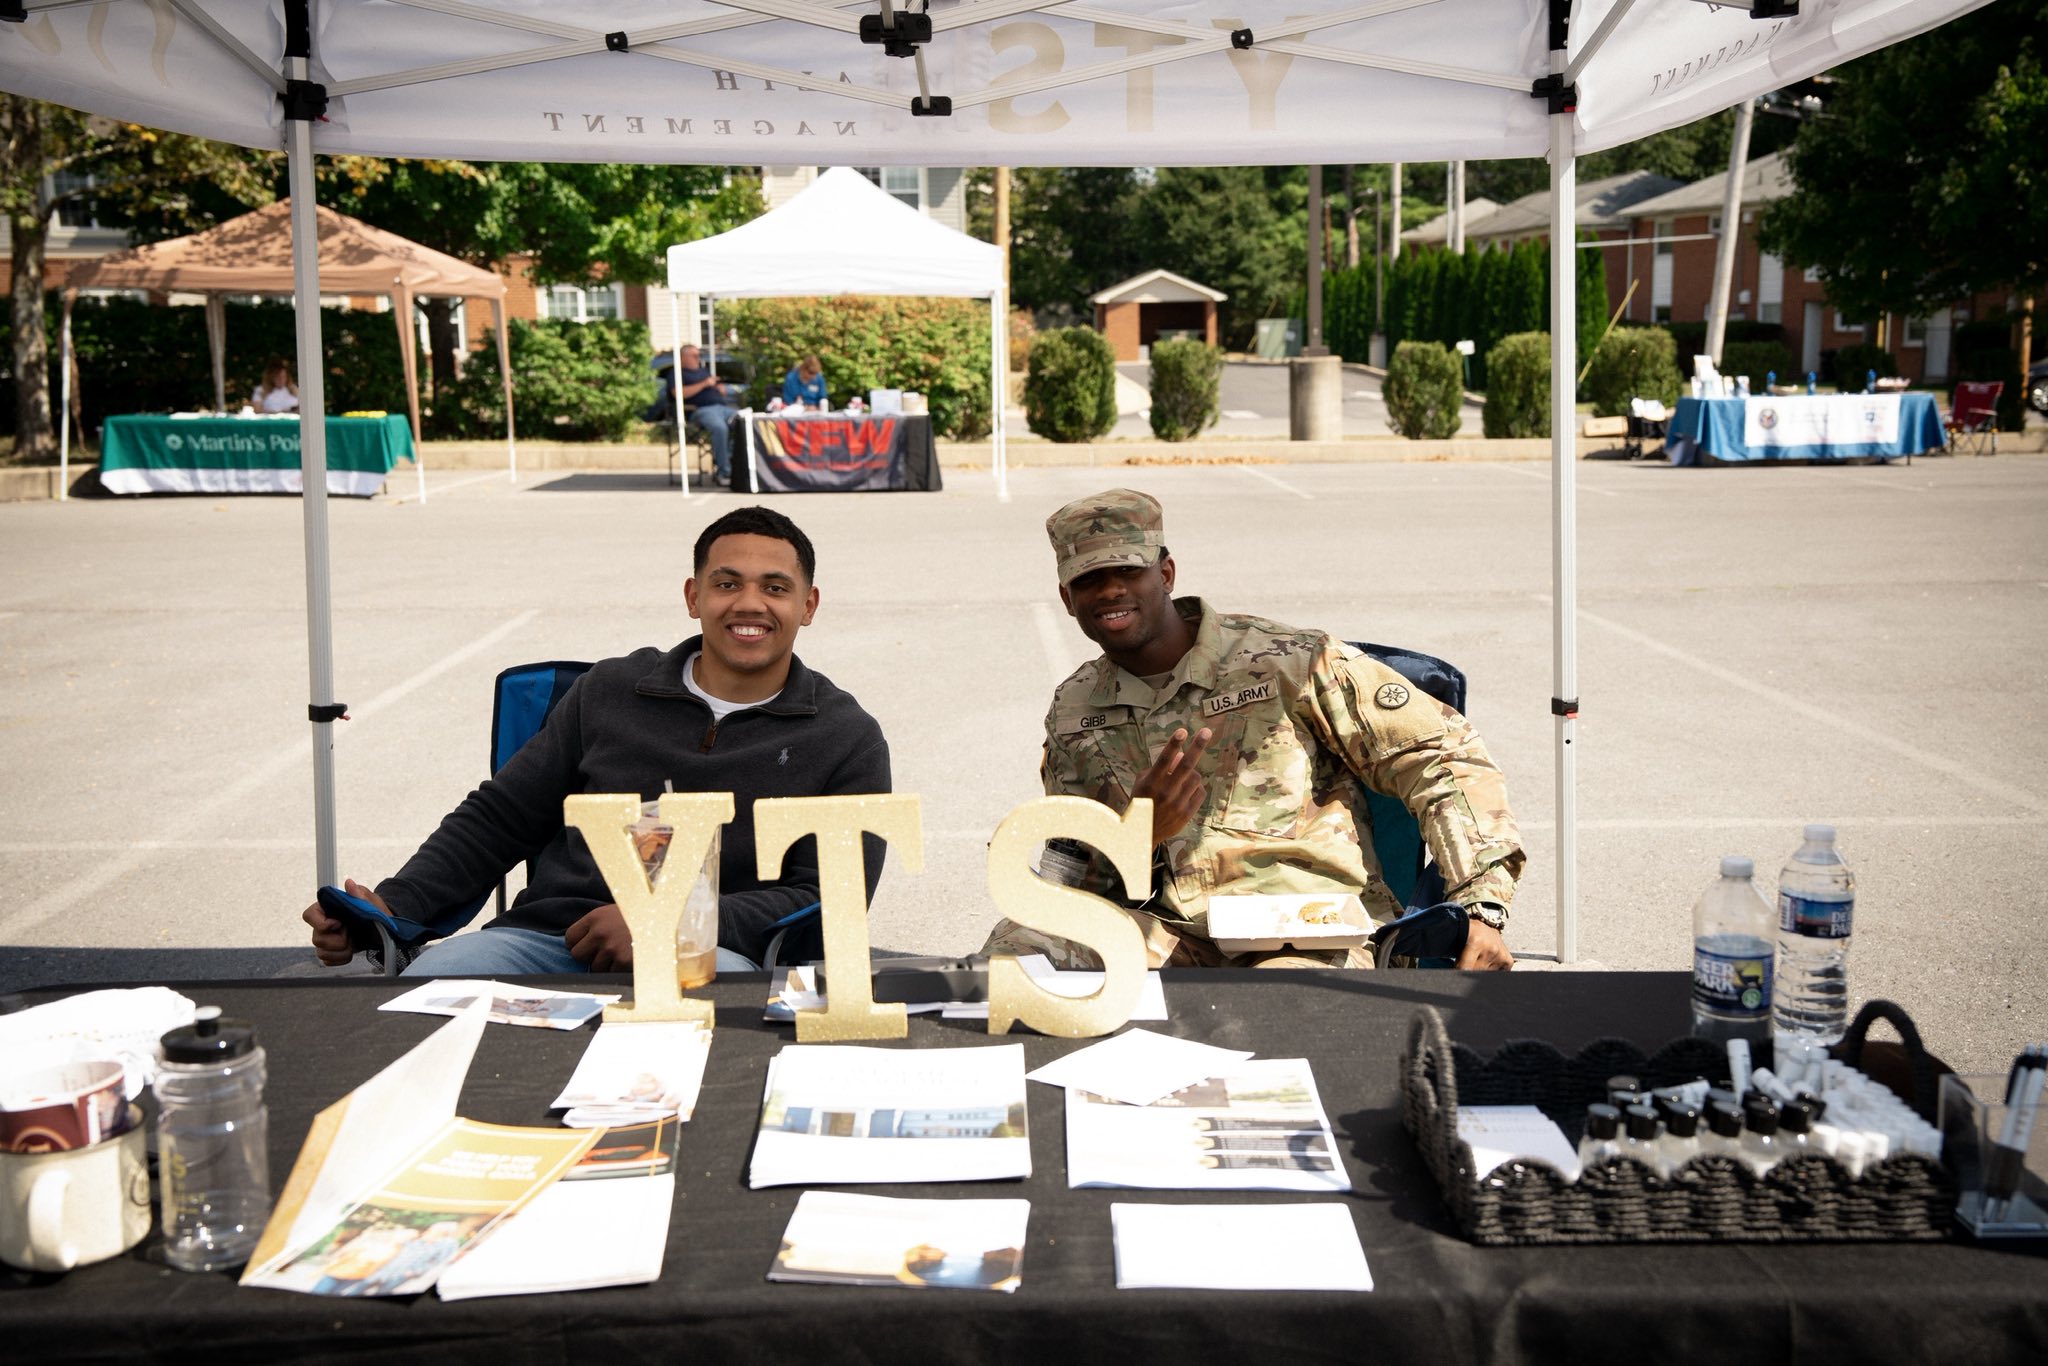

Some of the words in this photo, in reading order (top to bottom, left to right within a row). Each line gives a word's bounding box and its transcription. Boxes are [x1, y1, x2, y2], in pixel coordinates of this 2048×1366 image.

[186, 433, 266, 451] Martin's
[777, 419, 896, 456] VFW
[1210, 696, 1234, 712] U.S.
[1236, 684, 1270, 706] ARMY
[1080, 714, 1107, 729] GIBB
[563, 792, 1154, 1041] YTS
